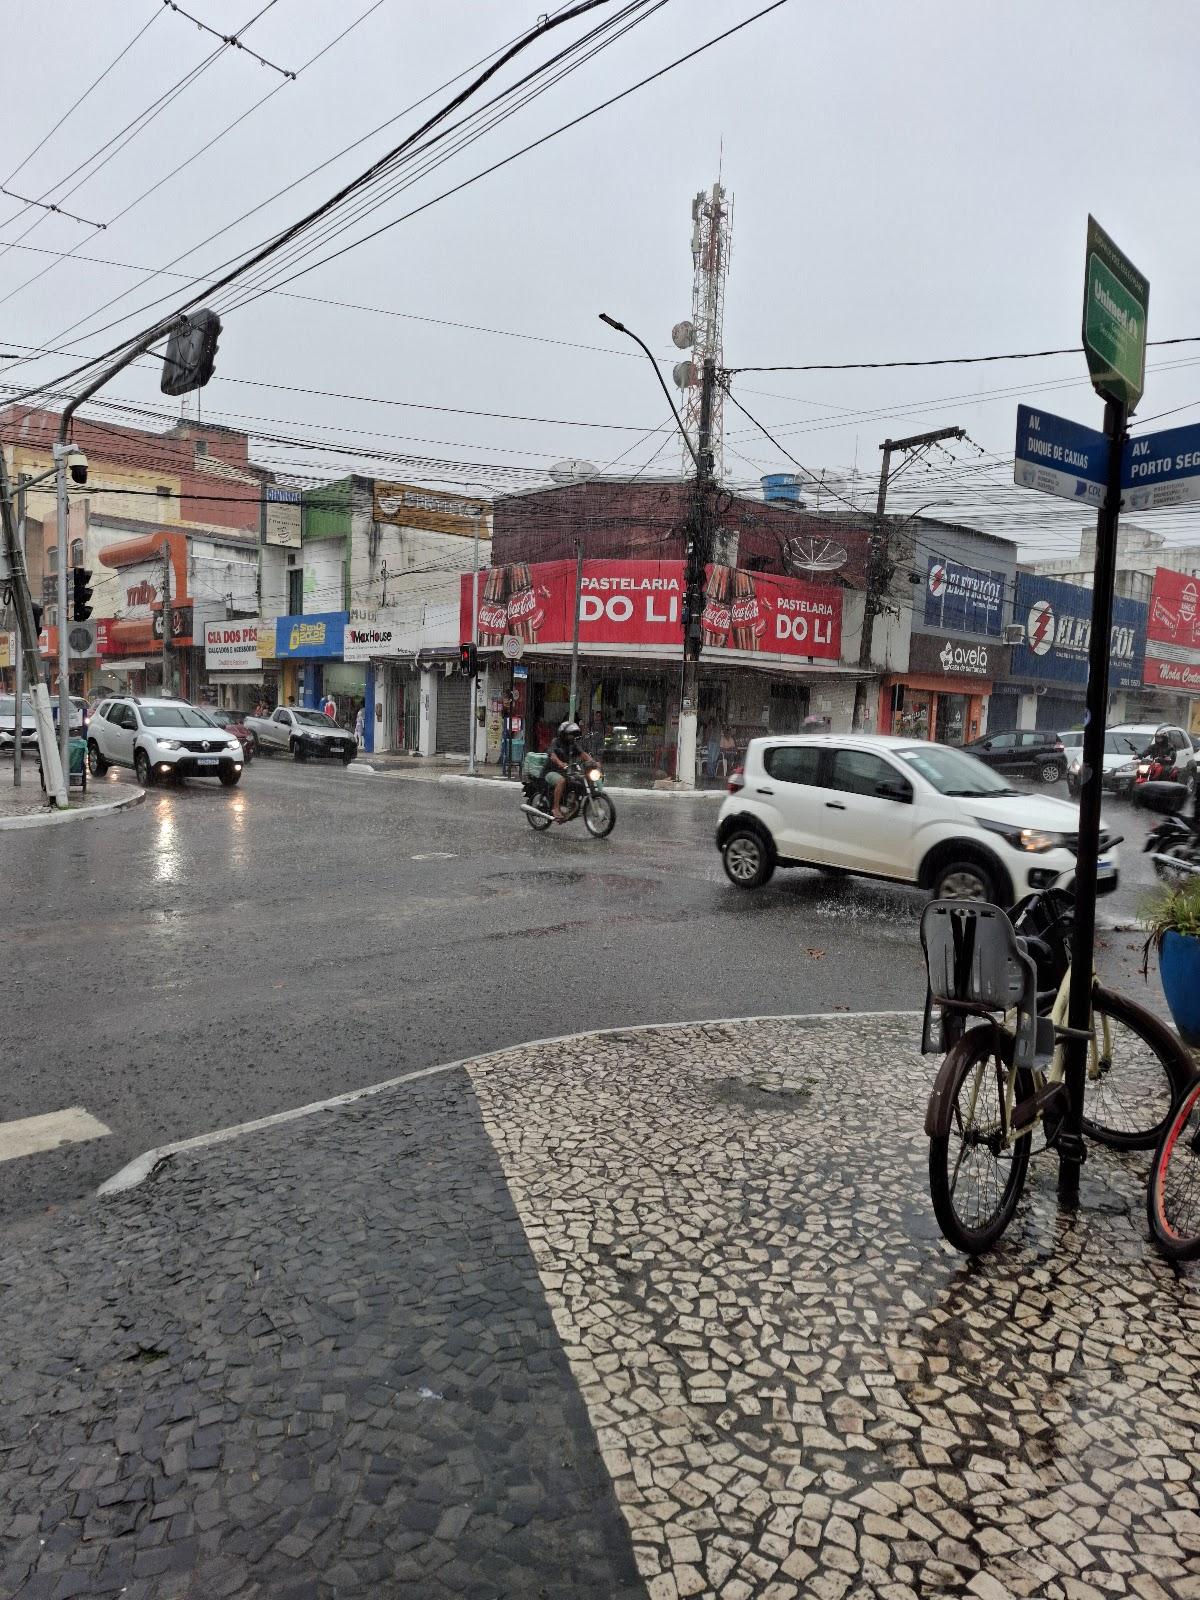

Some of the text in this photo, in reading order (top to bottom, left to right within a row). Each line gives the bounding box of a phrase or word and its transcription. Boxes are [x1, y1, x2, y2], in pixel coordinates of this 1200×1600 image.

[1094, 278, 1127, 329] Unimed
[1029, 415, 1041, 431] AV.
[1028, 437, 1089, 469] DUQUE DE CAXIAS
[1132, 441, 1150, 457] AV.
[1131, 457, 1172, 478] PORTO
[580, 577, 679, 590] PASTELARIA
[579, 595, 678, 622] DO LI
[777, 597, 833, 615] PASTELARIA
[208, 625, 257, 643] CIA DOS PÉS
[776, 613, 832, 644] DO LI
